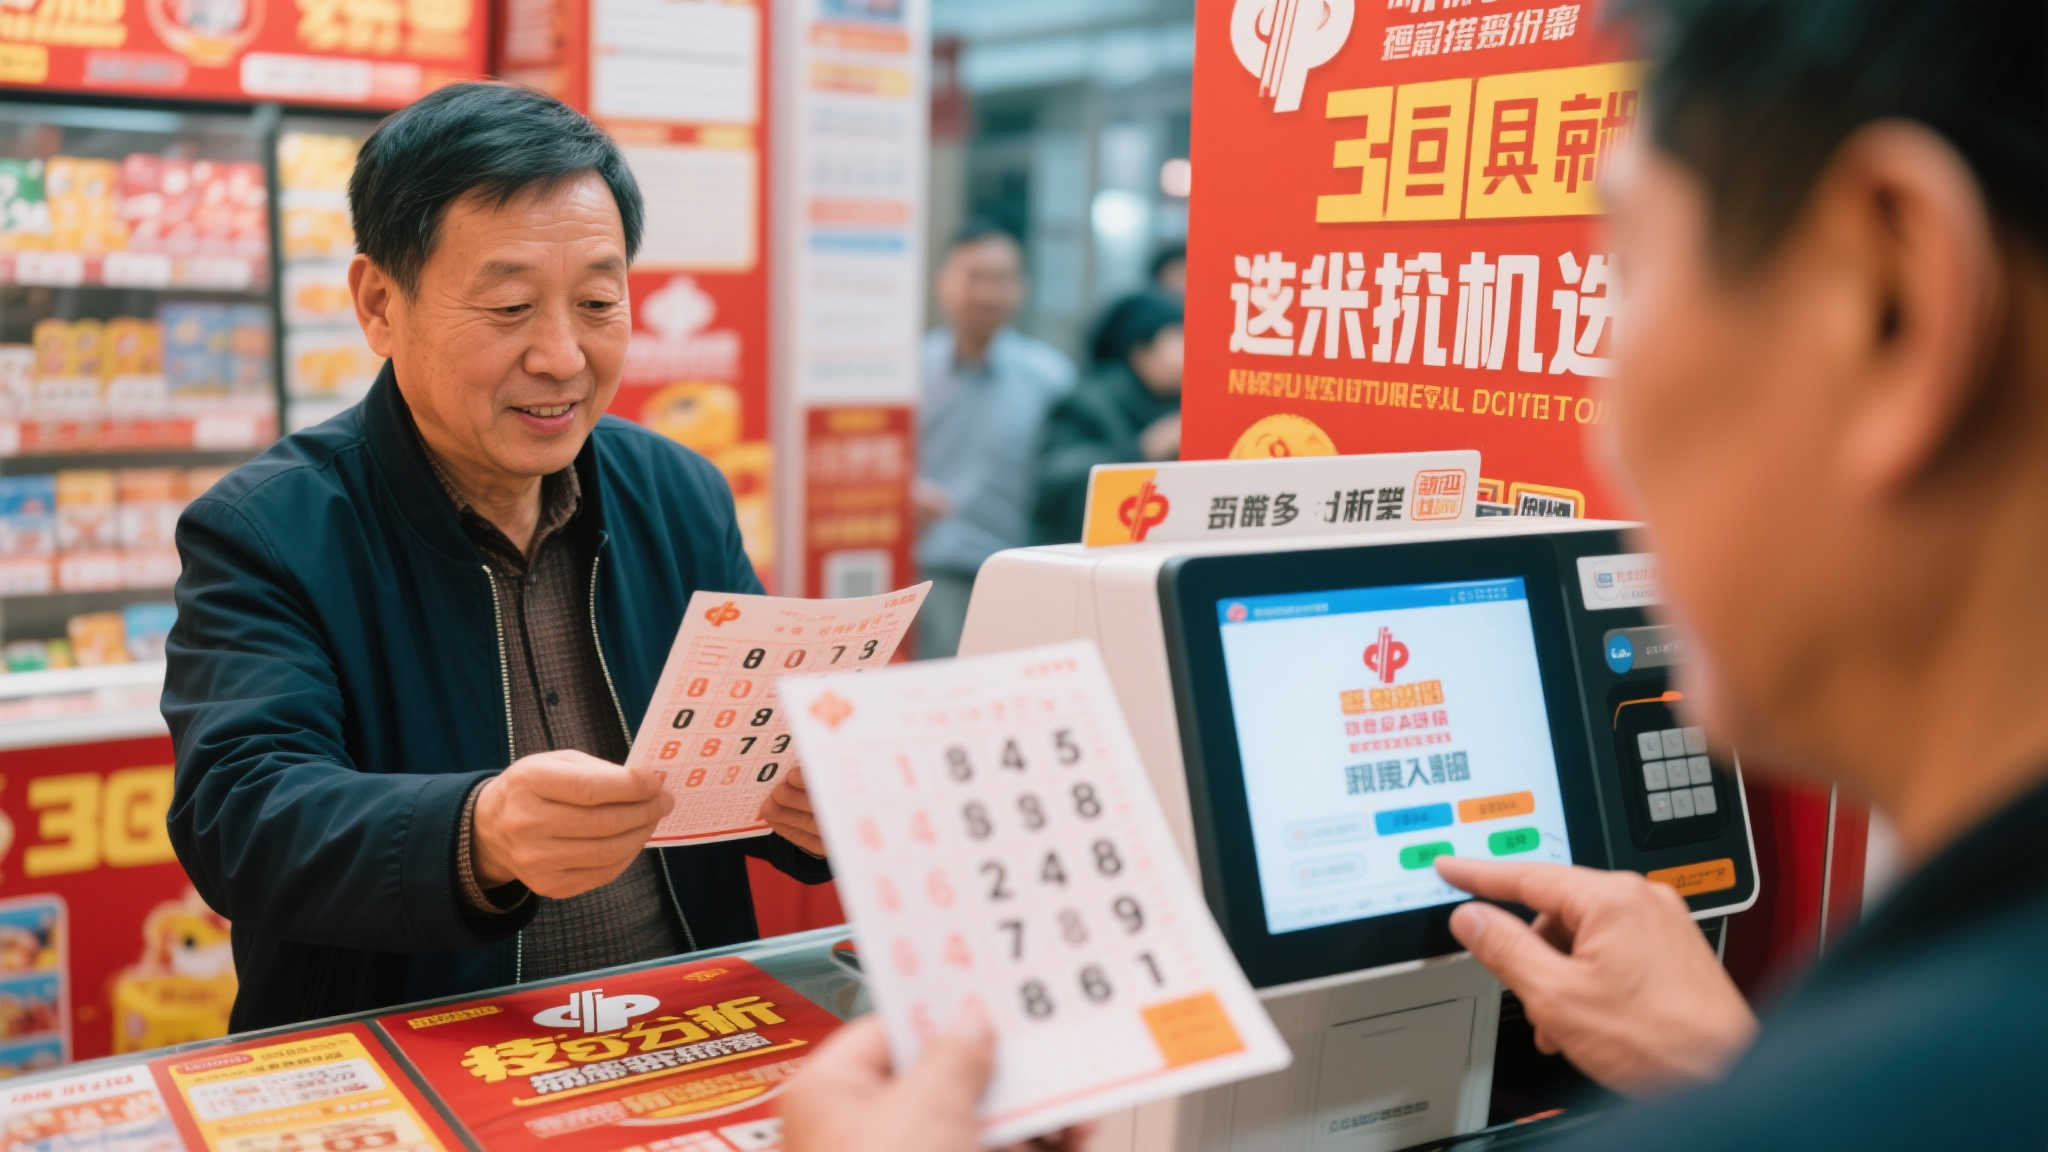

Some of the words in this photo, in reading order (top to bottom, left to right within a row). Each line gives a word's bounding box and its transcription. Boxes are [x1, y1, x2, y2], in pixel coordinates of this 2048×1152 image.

[784, 649, 806, 668] 0
[830, 646, 847, 664] 7
[672, 709, 695, 729] 0
[740, 736, 757, 755] 7
[770, 734, 791, 754] 3
[1000, 737, 1026, 772] 4
[1053, 728, 1081, 766] 5
[757, 763, 779, 782] 0
[1071, 781, 1102, 819] 8
[980, 859, 1013, 901] 2
[1040, 850, 1067, 888] 4
[1092, 838, 1122, 877] 8
[998, 917, 1025, 961] 7
[1113, 895, 1145, 934] 9
[1021, 978, 1055, 1020] 8
[1079, 963, 1114, 1003] 6
[1137, 952, 1165, 987] 1
